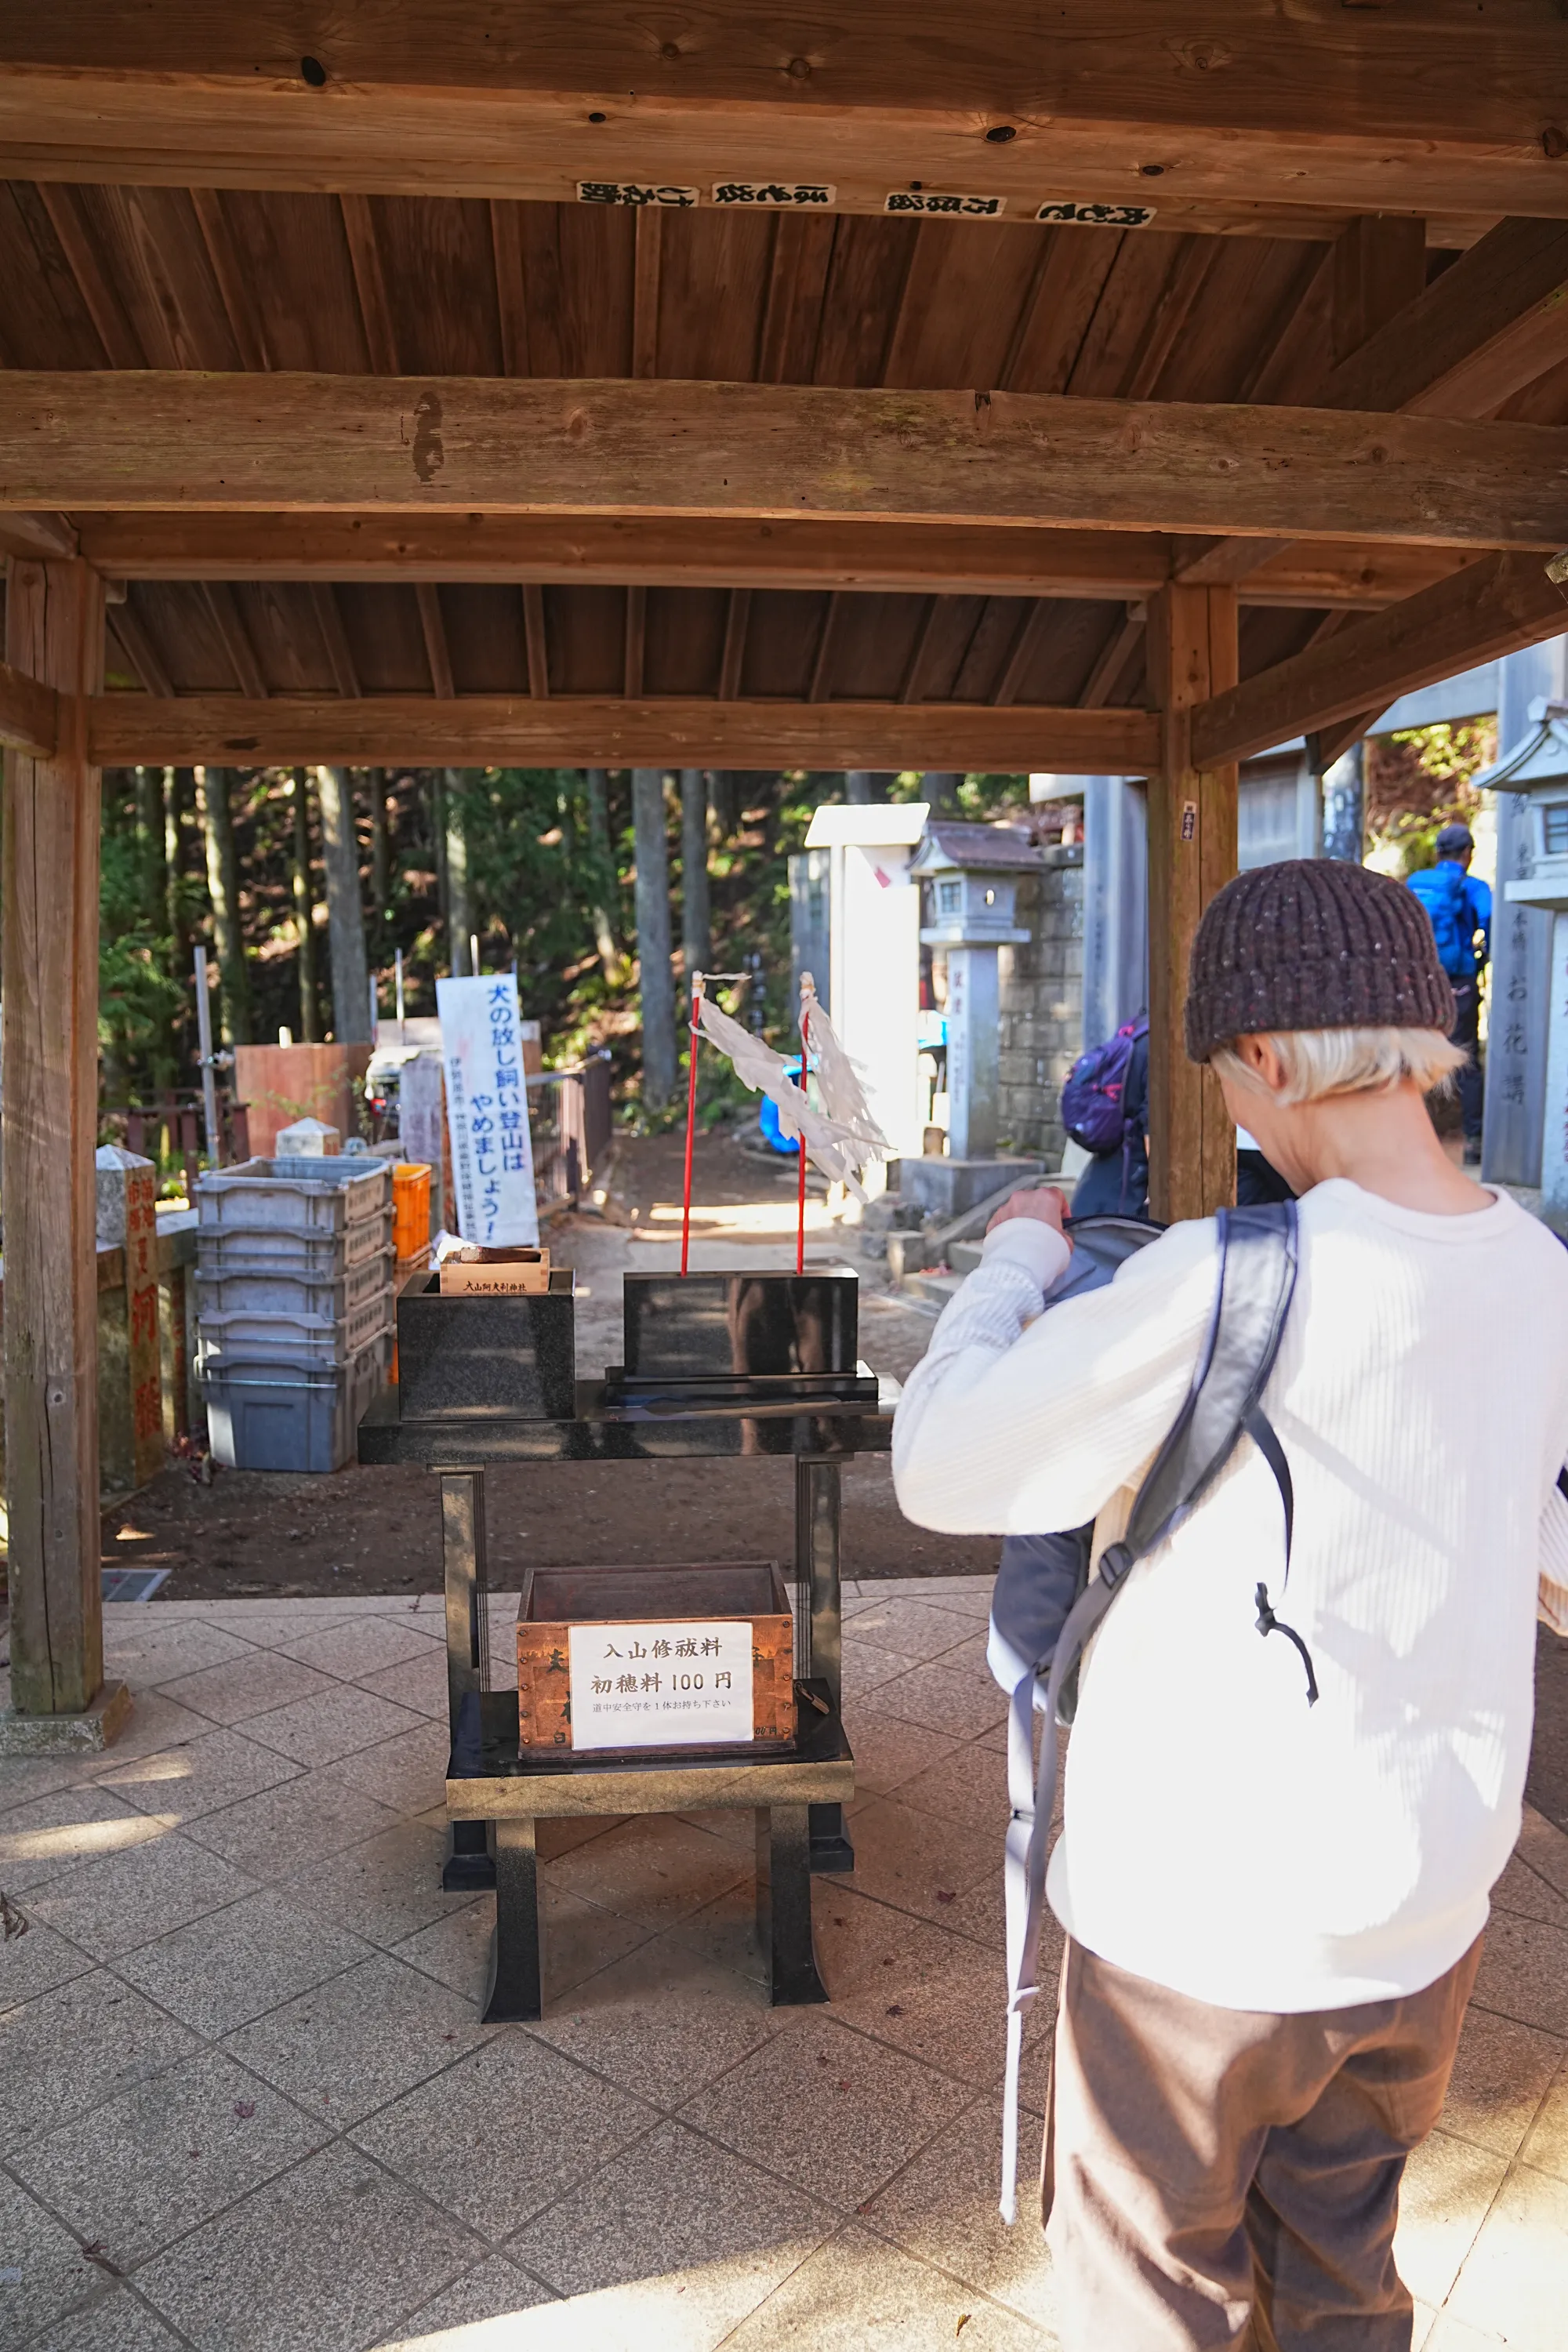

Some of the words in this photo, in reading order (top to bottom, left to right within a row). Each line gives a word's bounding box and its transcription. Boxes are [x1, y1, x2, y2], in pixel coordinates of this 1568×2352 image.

[488, 983, 524, 1171] 犬の放し飼い登山は
[470, 1094, 501, 1241] やめましょう！
[463, 1280, 527, 1292] 大山阿夫利神社
[603, 1636, 723, 1660] 入山修祓料
[590, 1672, 662, 1694] 初穂料
[672, 1673, 704, 1691] 100
[715, 1671, 732, 1689] 円
